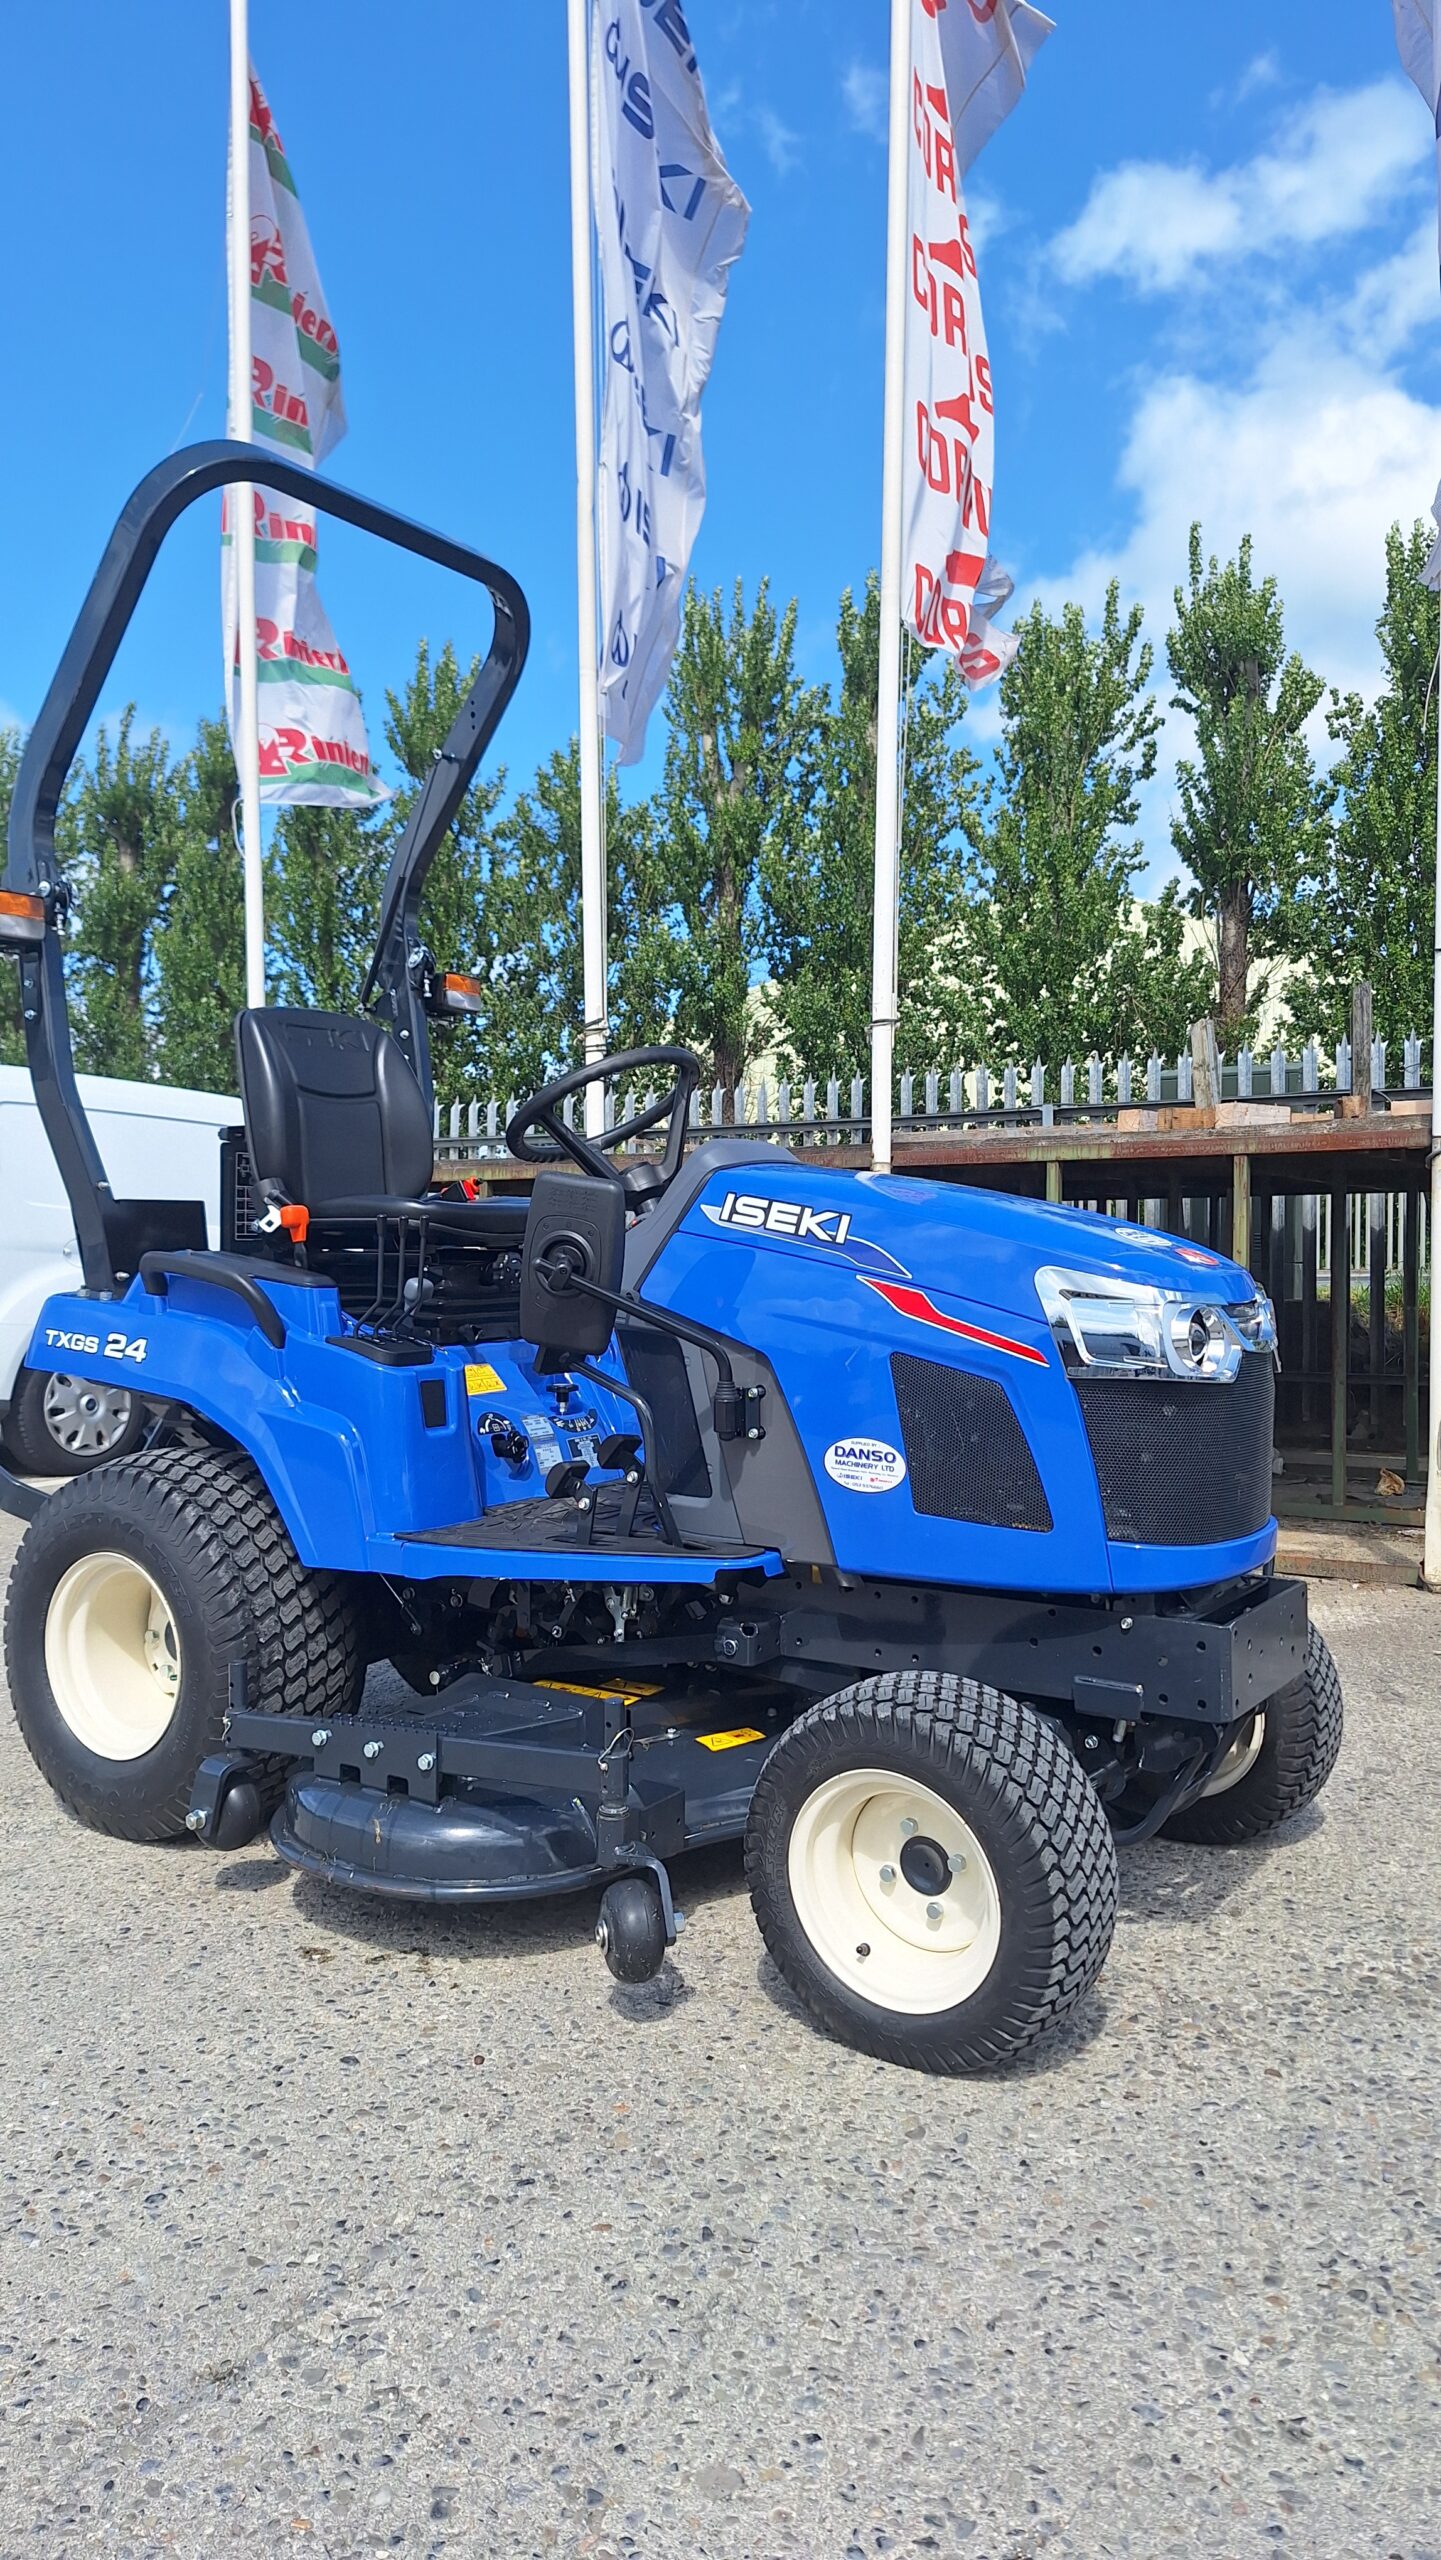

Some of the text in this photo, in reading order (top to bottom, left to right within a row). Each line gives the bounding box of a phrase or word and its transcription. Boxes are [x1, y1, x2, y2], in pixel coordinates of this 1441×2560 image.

[719, 1191, 852, 1245] ISEKI
[45, 1329, 148, 1363] TXGS 24
[834, 1445, 897, 1464] DANSO
[835, 1459, 879, 1471] MACHINERY
[881, 1465, 895, 1473] LTD
